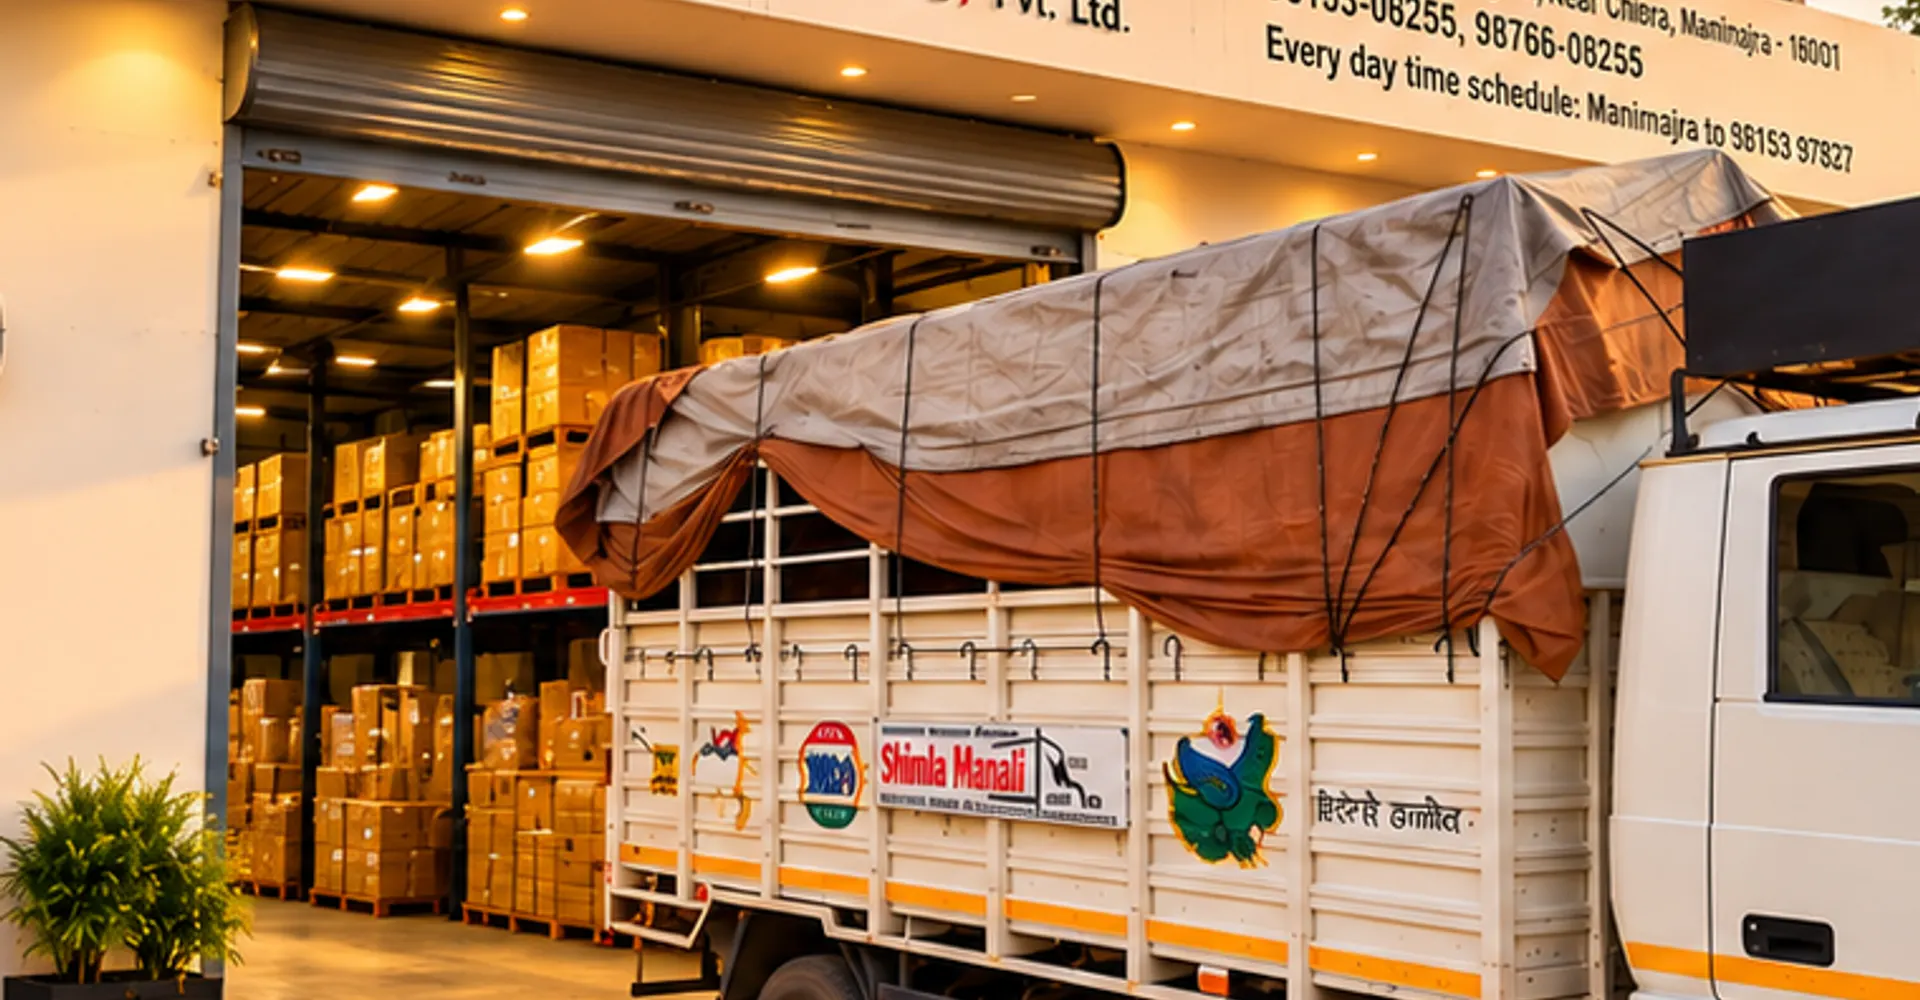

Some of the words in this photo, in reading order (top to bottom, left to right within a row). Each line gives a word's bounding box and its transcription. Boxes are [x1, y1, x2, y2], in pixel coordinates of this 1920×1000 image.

[1474, 11, 1644, 78] 98766-08255
[1265, 24, 1341, 81] Every
[1349, 44, 1397, 92] day
[1404, 56, 1460, 96] time
[1467, 72, 1581, 119] schedule:
[1704, 117, 1725, 147] to
[880, 742, 947, 788] Shimla
[952, 744, 1026, 793] Manali
